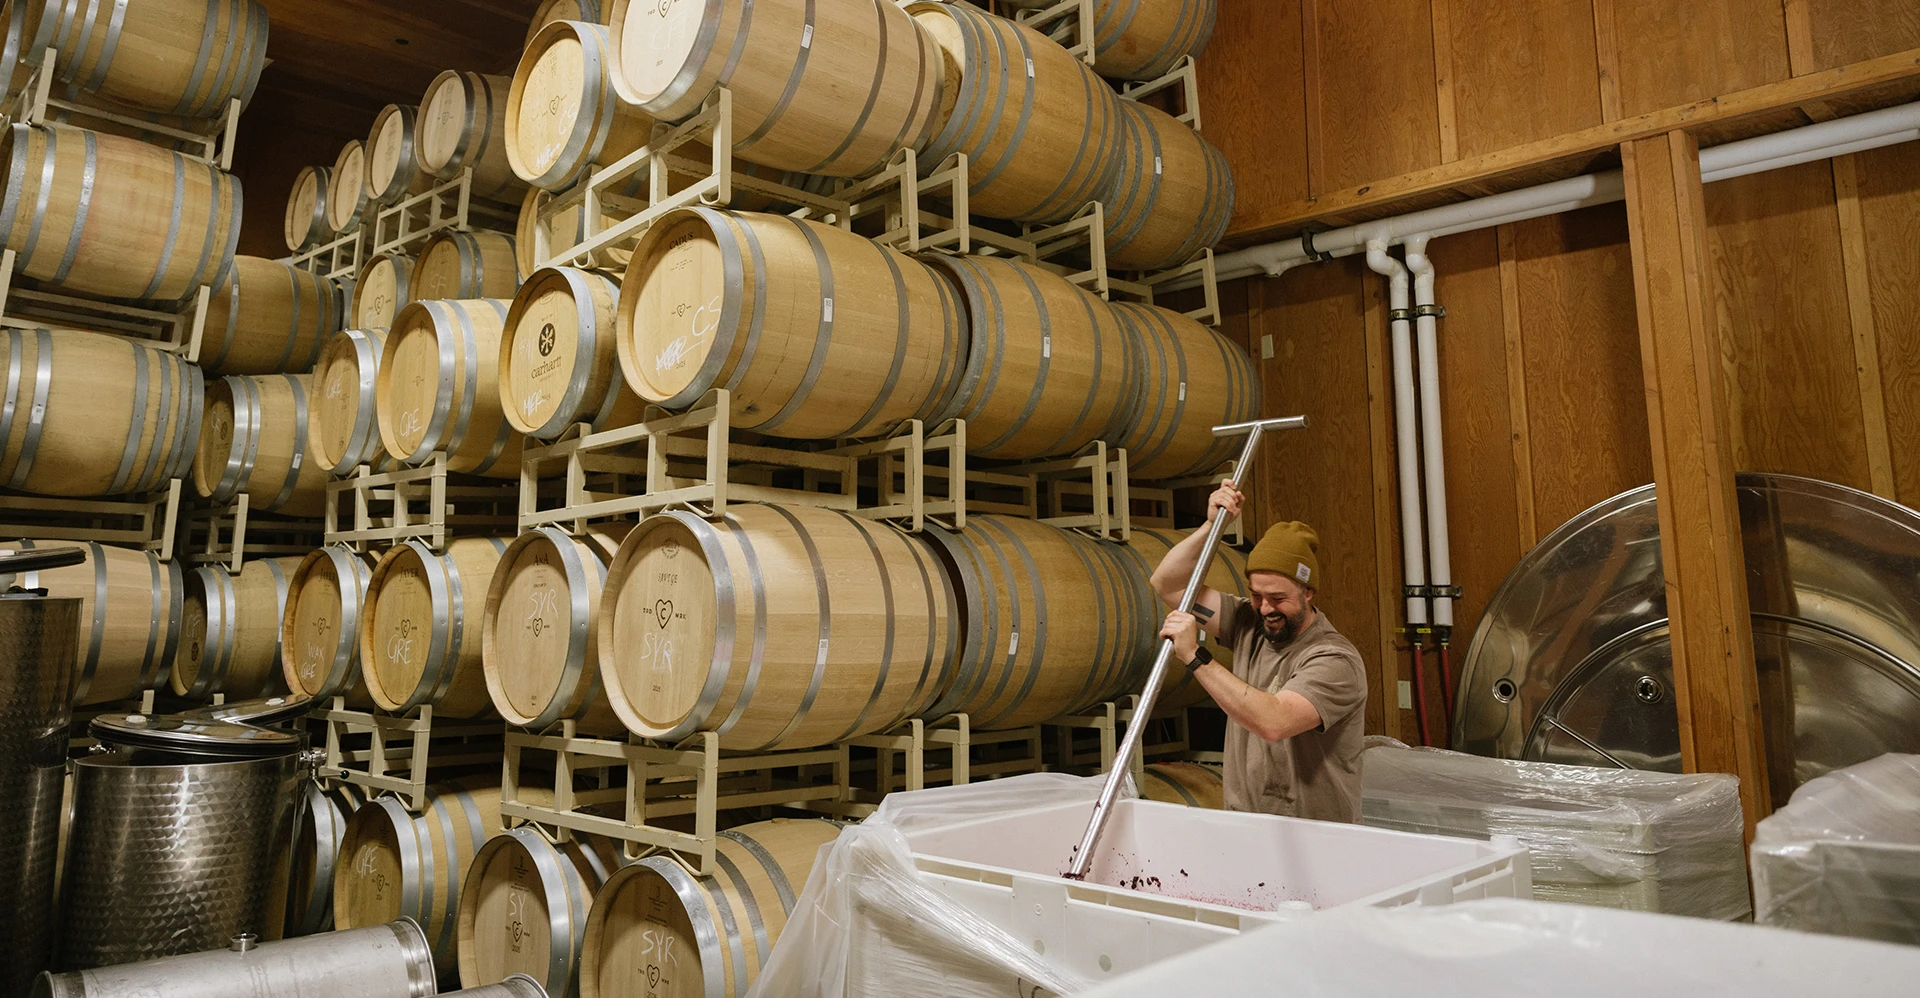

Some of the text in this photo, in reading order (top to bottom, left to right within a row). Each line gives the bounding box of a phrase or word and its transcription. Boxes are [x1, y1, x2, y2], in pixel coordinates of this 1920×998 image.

[669, 231, 694, 250] CADUS
[692, 295, 721, 336] CS
[528, 589, 558, 620] SYR
[387, 634, 413, 664] GRE
[640, 632, 673, 679] SYR
[641, 930, 678, 967] SYR
